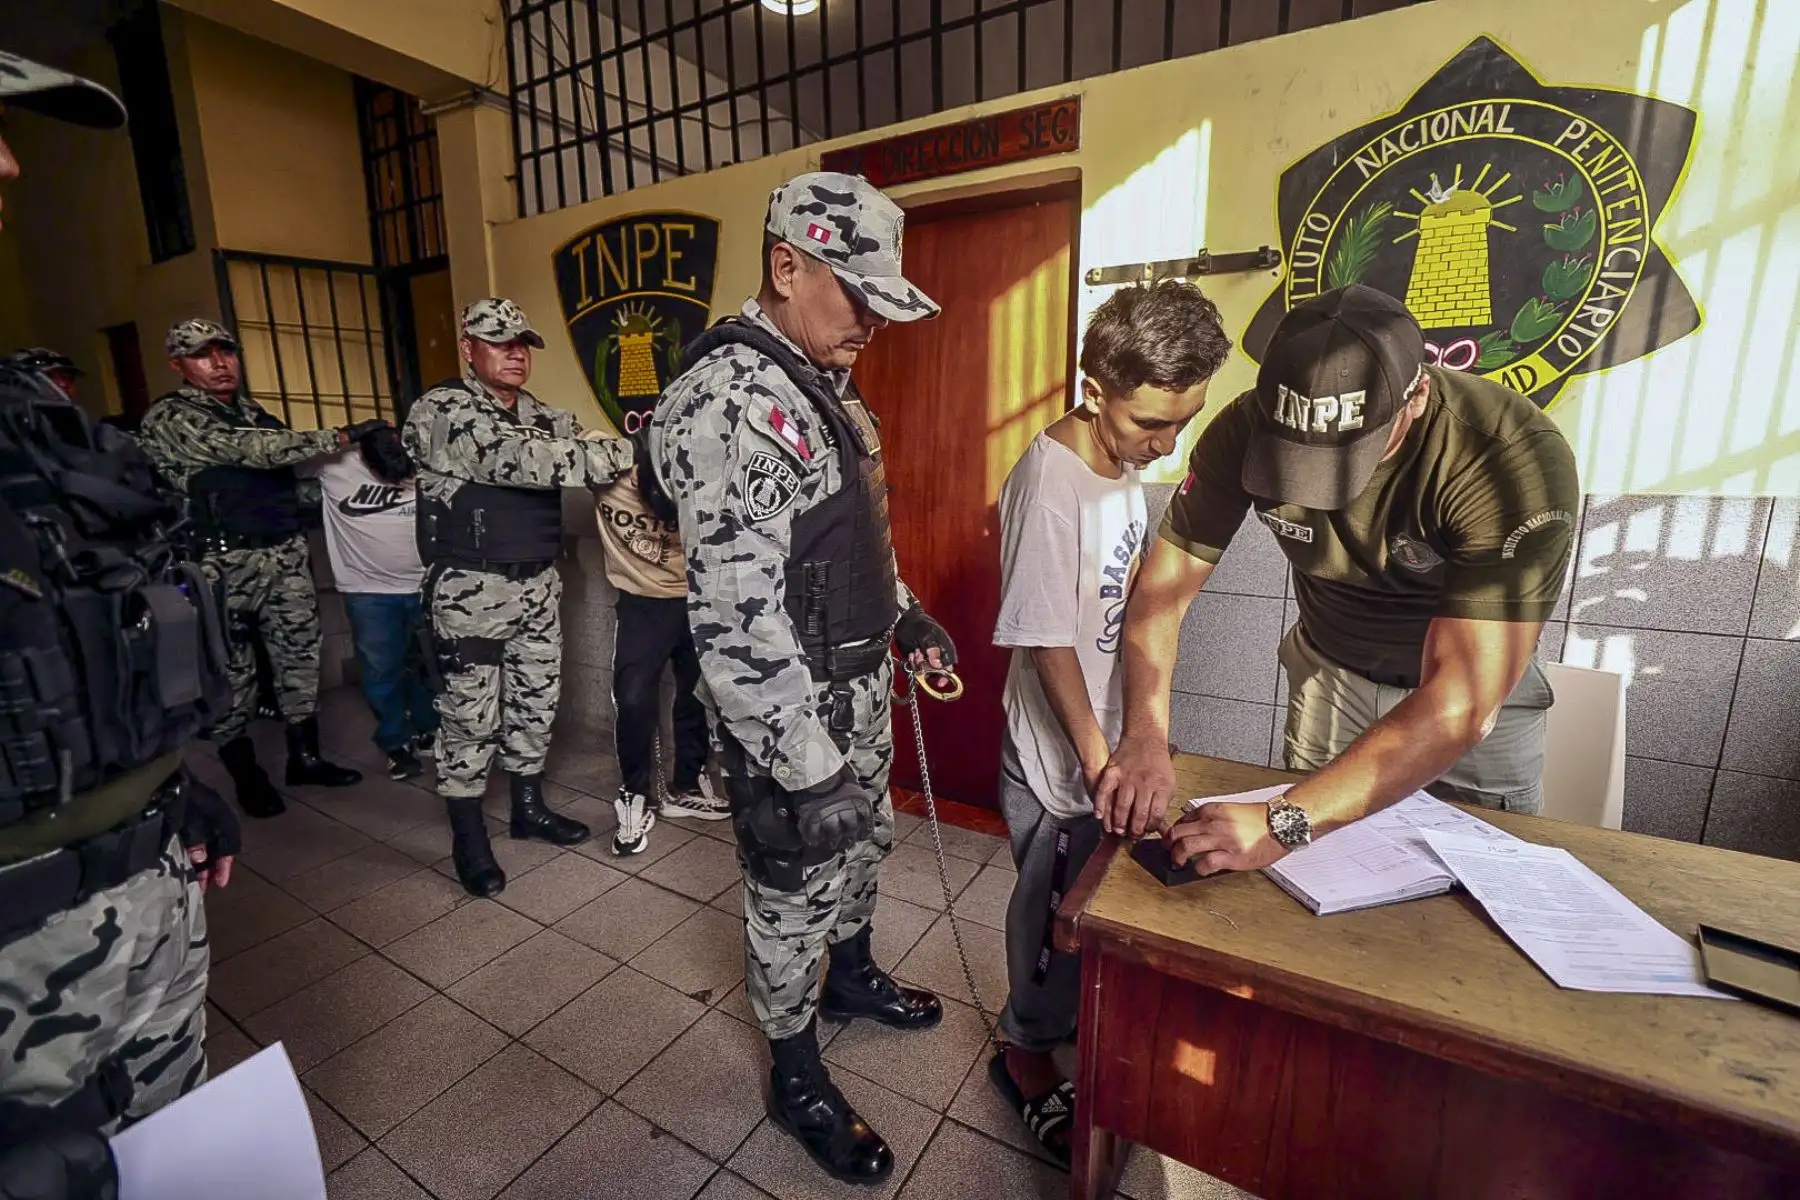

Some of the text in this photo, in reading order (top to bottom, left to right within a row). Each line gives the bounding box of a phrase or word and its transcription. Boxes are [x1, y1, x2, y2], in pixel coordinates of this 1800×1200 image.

[1289, 104, 1643, 357] ITUTO NACIONAL PENITENCIARIO
[571, 223, 697, 311] INPE
[1274, 383, 1367, 433] INPE
[349, 483, 405, 505] NIKE
[753, 456, 797, 491] INPE
